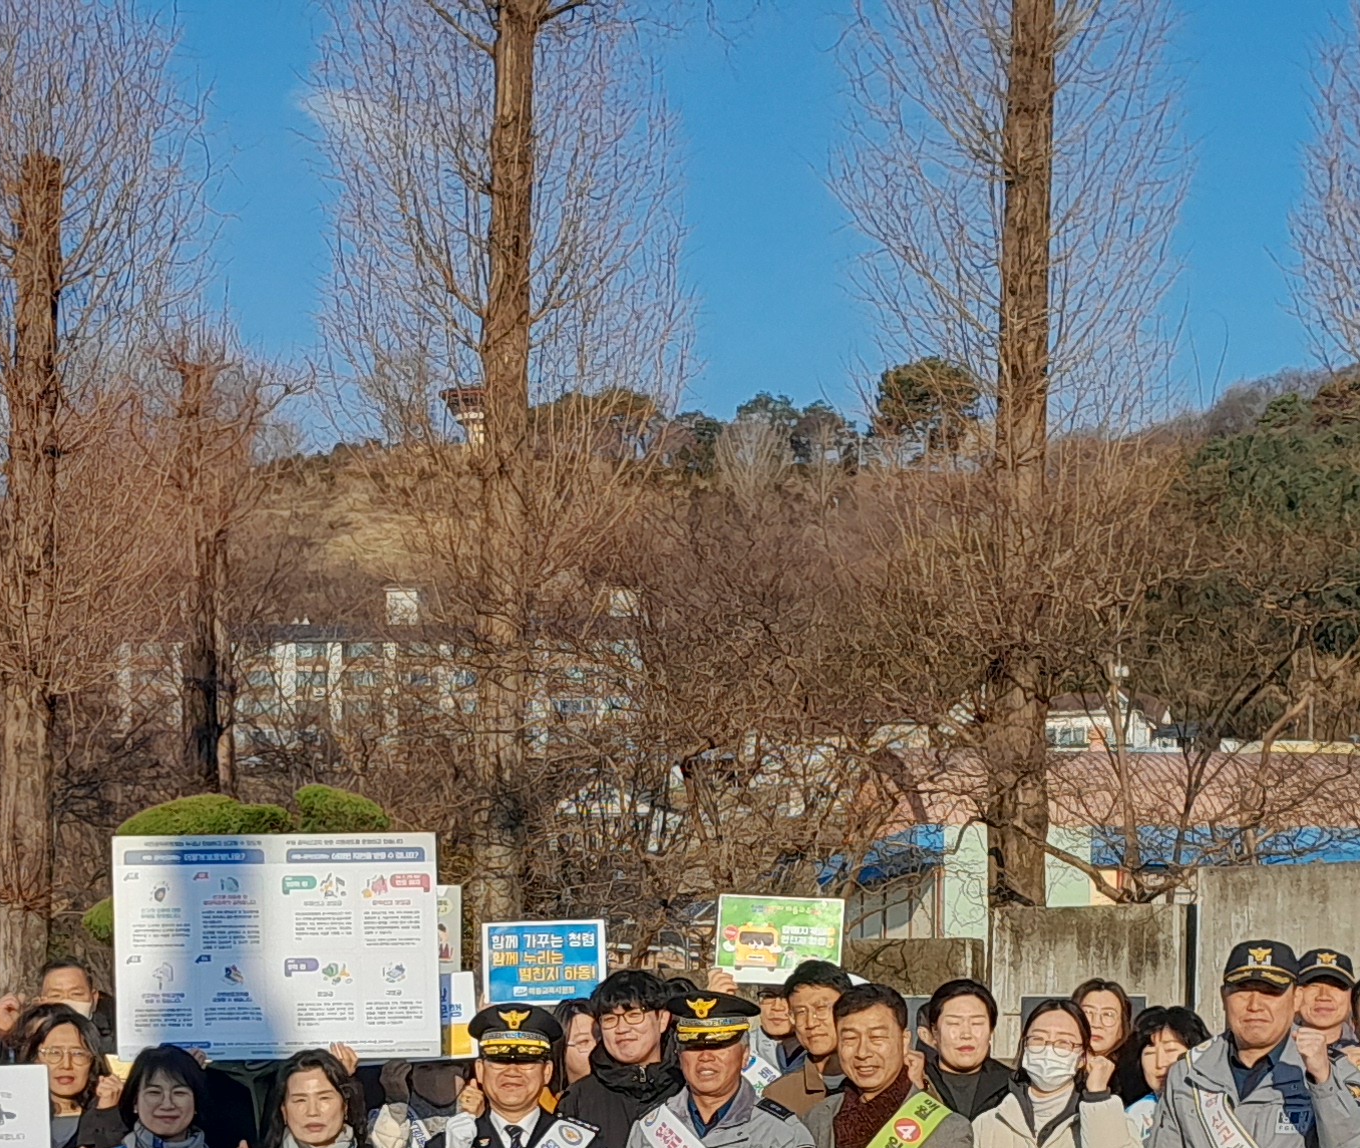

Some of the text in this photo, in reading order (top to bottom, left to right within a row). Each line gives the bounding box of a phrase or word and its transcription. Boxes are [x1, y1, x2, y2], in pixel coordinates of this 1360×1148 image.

[491, 932, 595, 950] 함께 가꾸는 청렴
[492, 951, 564, 966] 함께 누리는
[564, 965, 596, 981] 하동!
